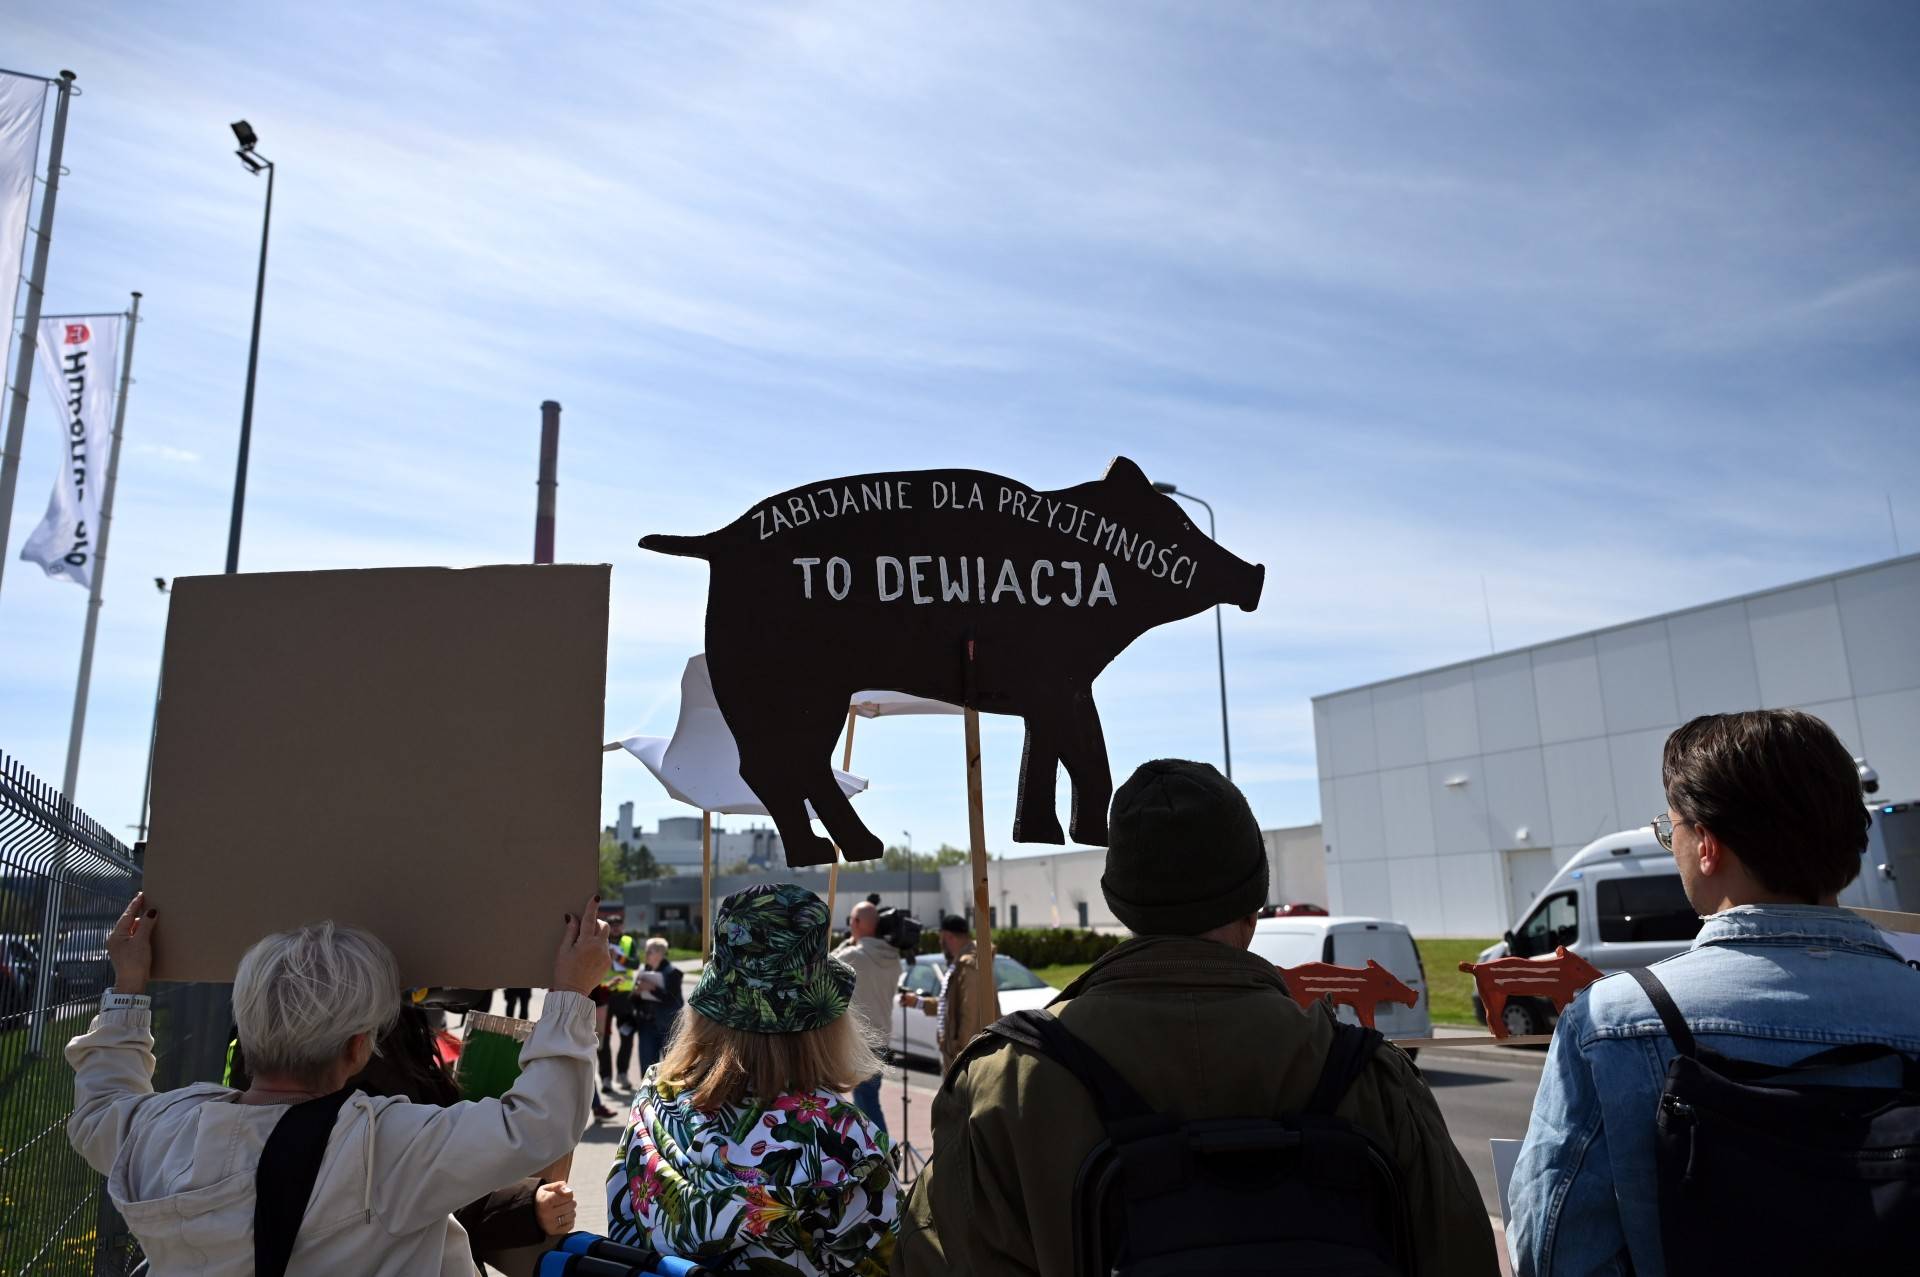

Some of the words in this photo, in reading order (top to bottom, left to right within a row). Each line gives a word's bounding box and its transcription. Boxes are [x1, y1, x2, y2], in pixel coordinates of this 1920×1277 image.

[751, 480, 914, 541] ZABIJANIE
[931, 480, 985, 511] DLA
[998, 486, 1199, 590] PRZYJEMNOŚCI
[791, 556, 853, 601] TO
[874, 555, 1119, 608] DEWIACJA
